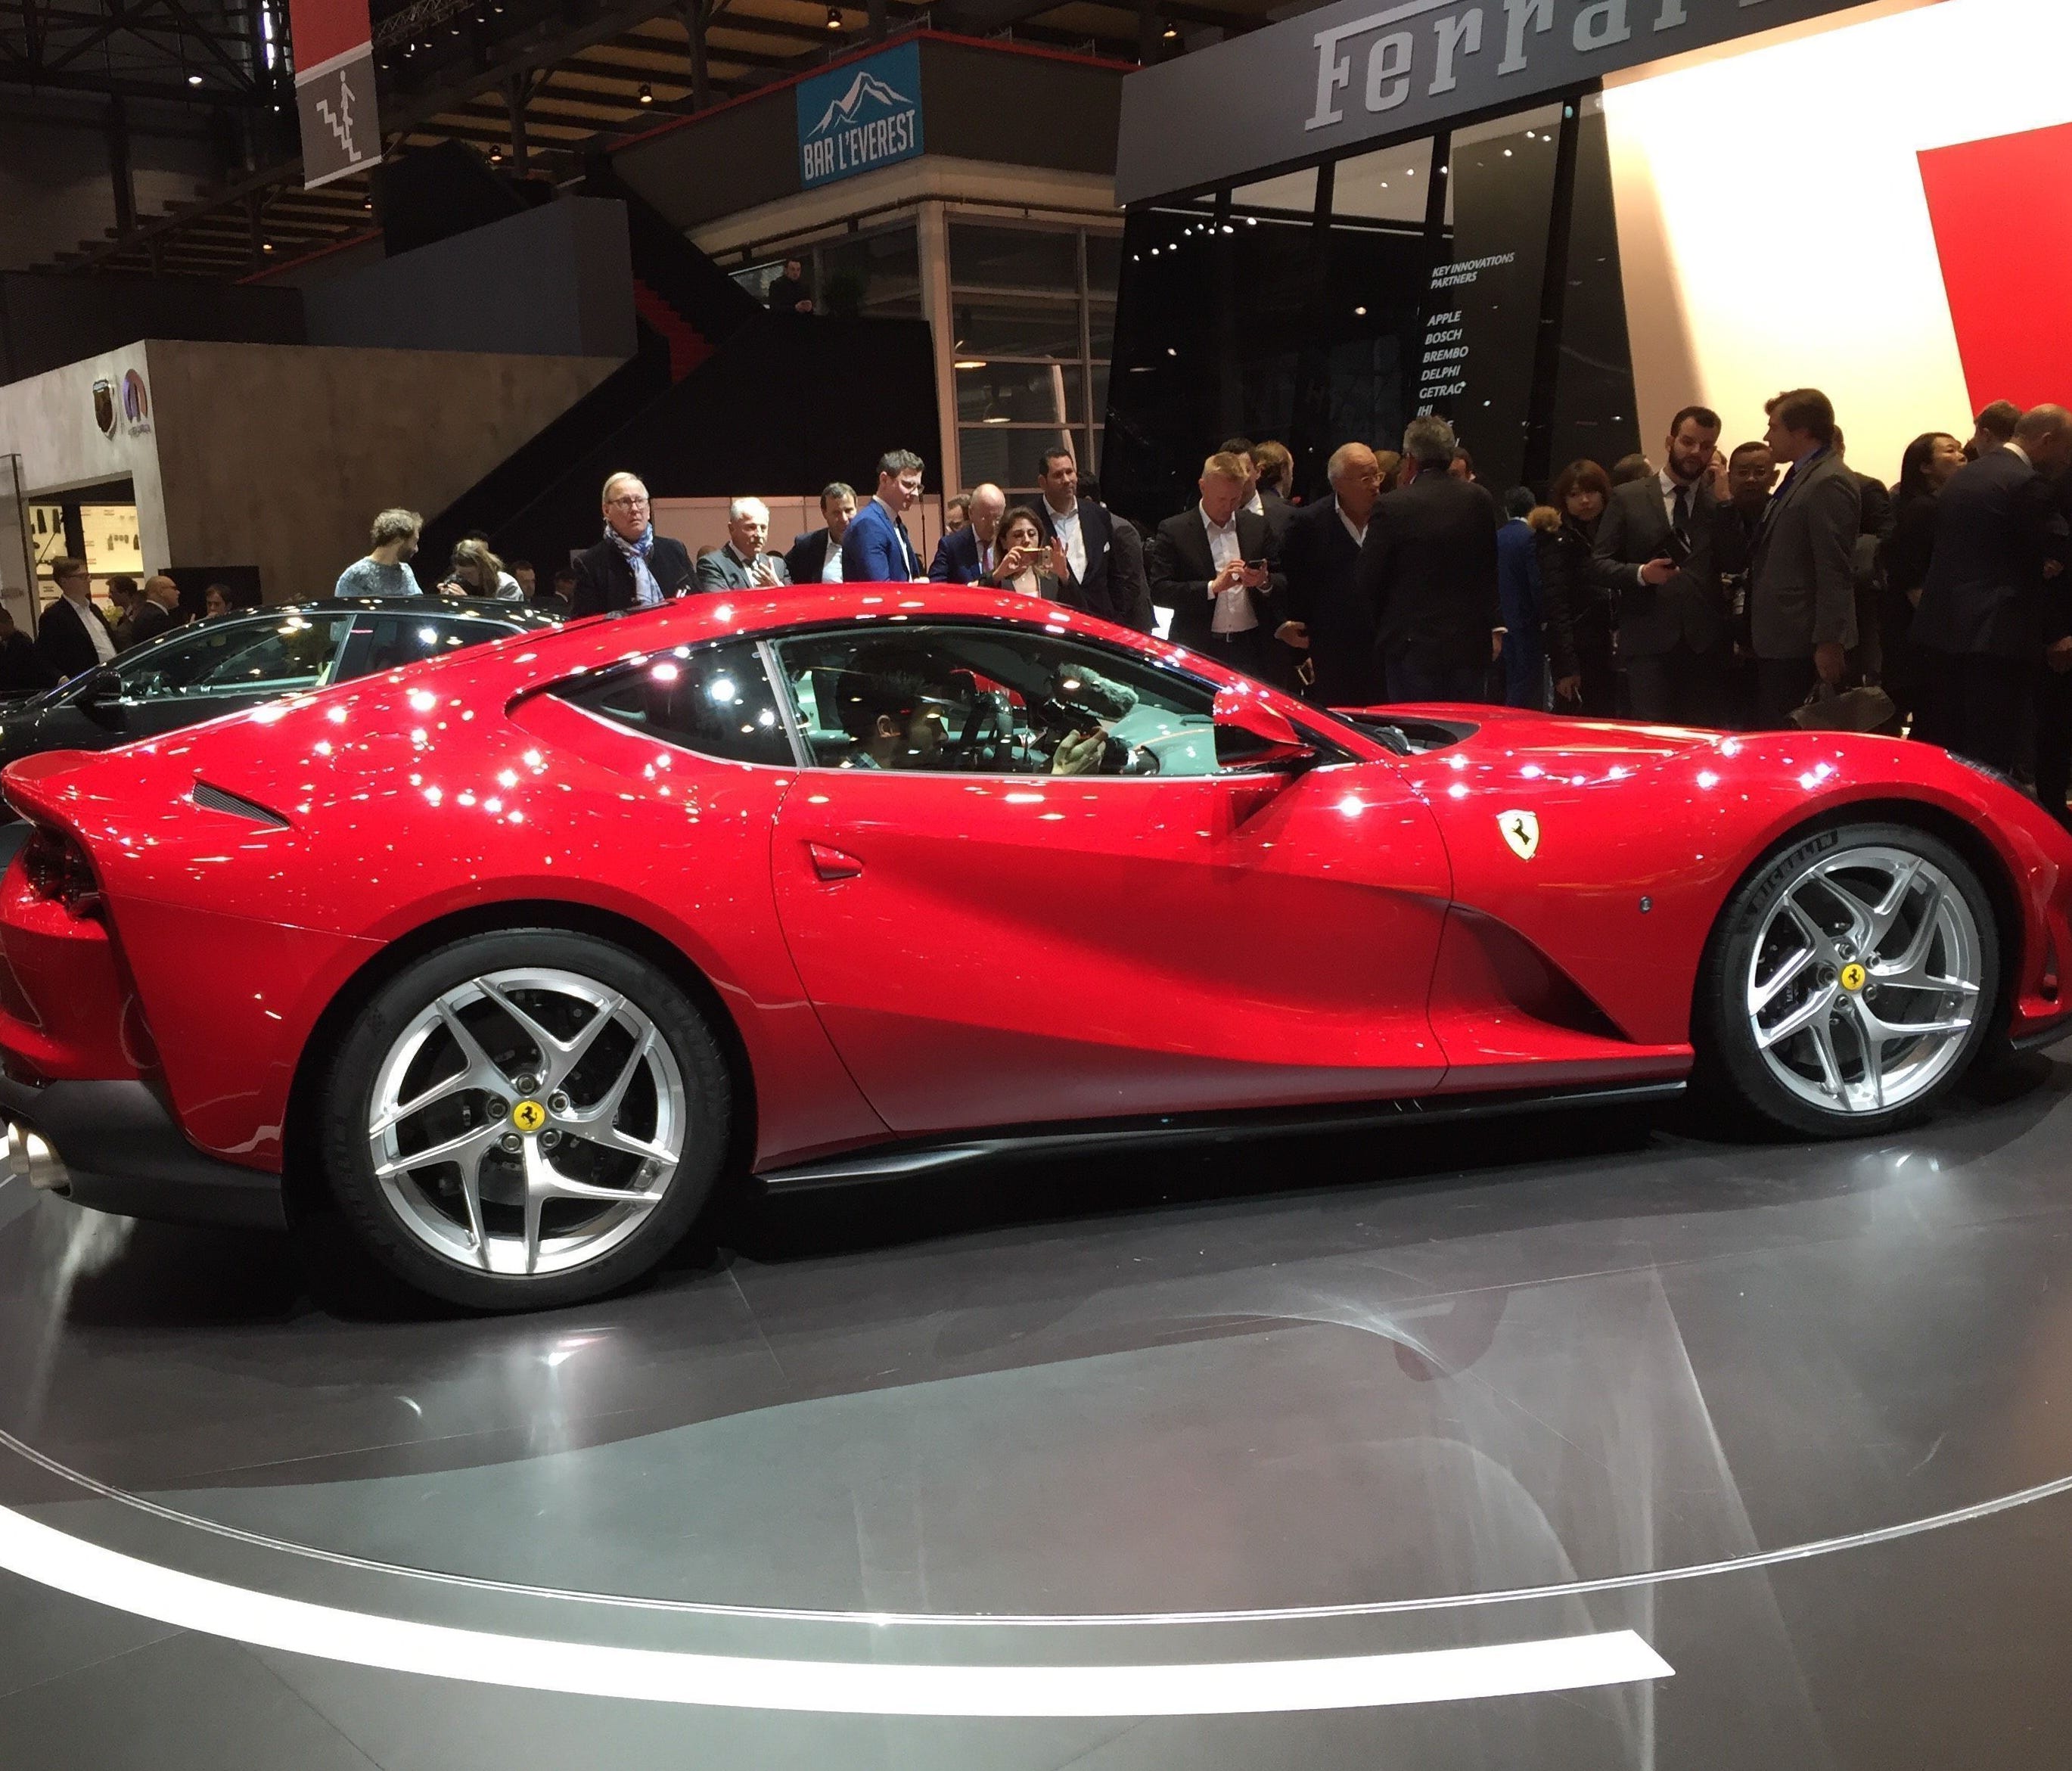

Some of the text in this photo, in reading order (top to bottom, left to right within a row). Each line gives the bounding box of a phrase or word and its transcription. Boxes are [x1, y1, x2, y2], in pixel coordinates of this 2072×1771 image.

[1305, 0, 1772, 130] Ferra
[803, 109, 915, 181] BAR L'EVEREST
[1432, 252, 1515, 278] KEY INNOVATIONS
[1431, 272, 1478, 289] PARTNERS
[1427, 310, 1462, 327] APPLE
[1424, 328, 1463, 345] BOSCH
[1423, 346, 1468, 363] BREMBO
[1421, 365, 1461, 381] DELPHI
[1419, 382, 1464, 399] GETRAG
[1417, 404, 1434, 417] IHI
